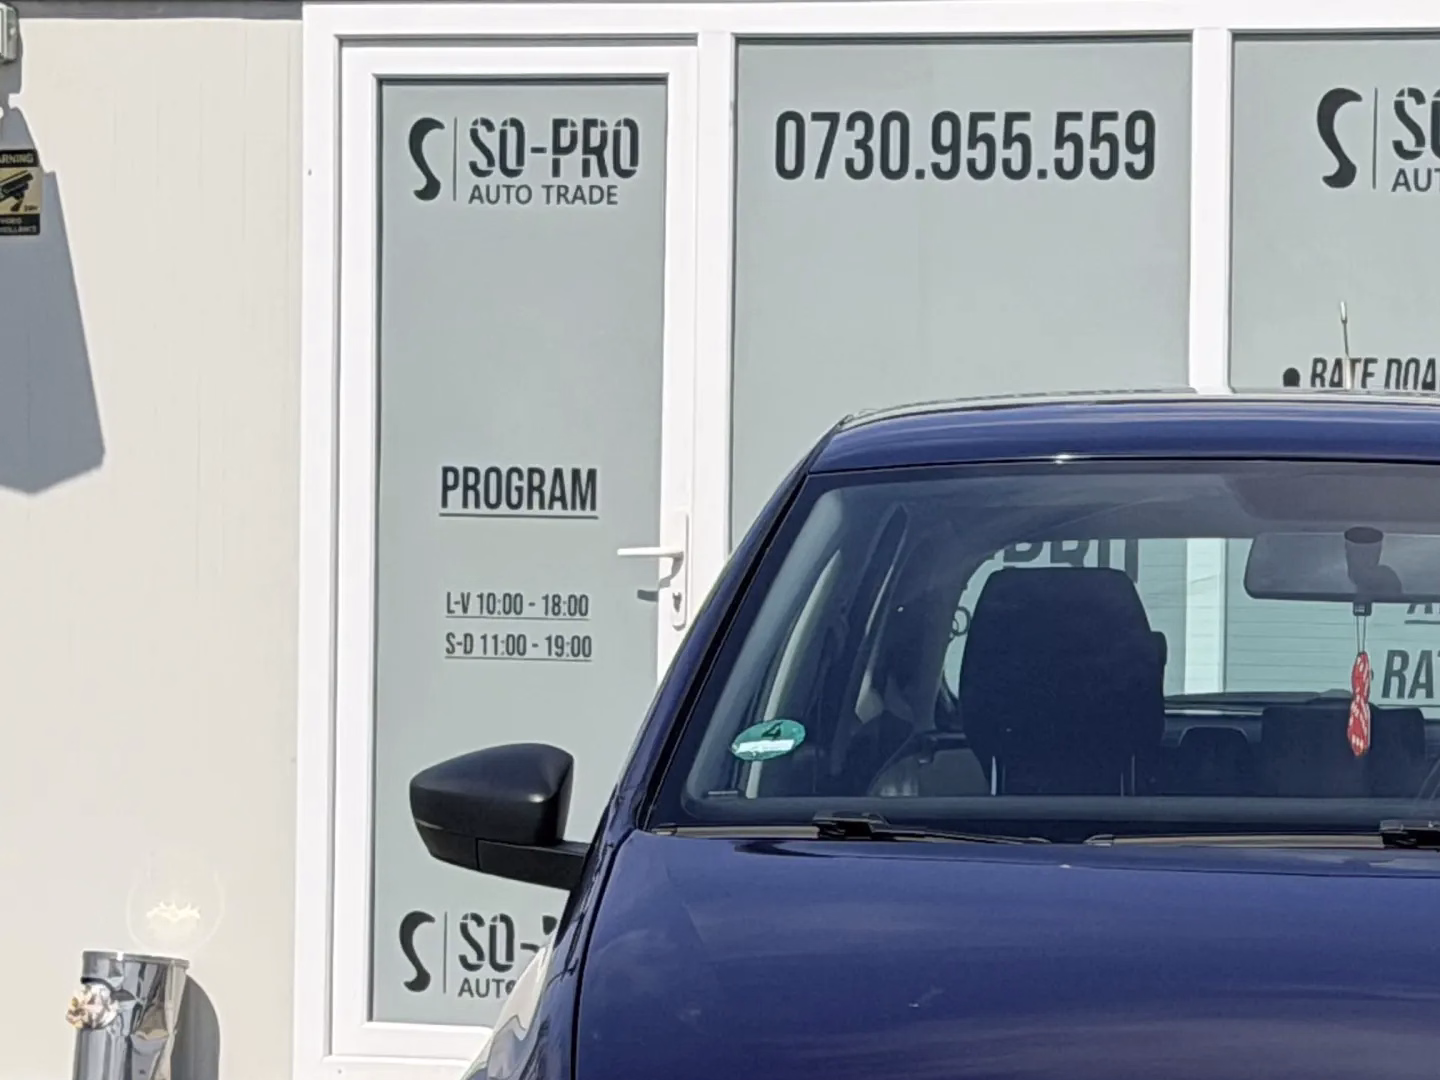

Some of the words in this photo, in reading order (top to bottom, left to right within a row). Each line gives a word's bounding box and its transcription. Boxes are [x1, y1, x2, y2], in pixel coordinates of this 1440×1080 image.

[468, 117, 639, 179] SO-PRO
[775, 109, 1156, 181] 0730.955.559
[468, 183, 533, 205] AUTO
[541, 184, 618, 206] TRADE
[1310, 357, 1378, 389] RATE
[440, 465, 598, 513] PROGRAM
[446, 591, 471, 615] L-V
[476, 592, 524, 616] 10:00
[541, 593, 590, 617] 18:00
[445, 631, 474, 655] S-D
[480, 633, 527, 657] 11:00
[544, 634, 592, 658] 19:00
